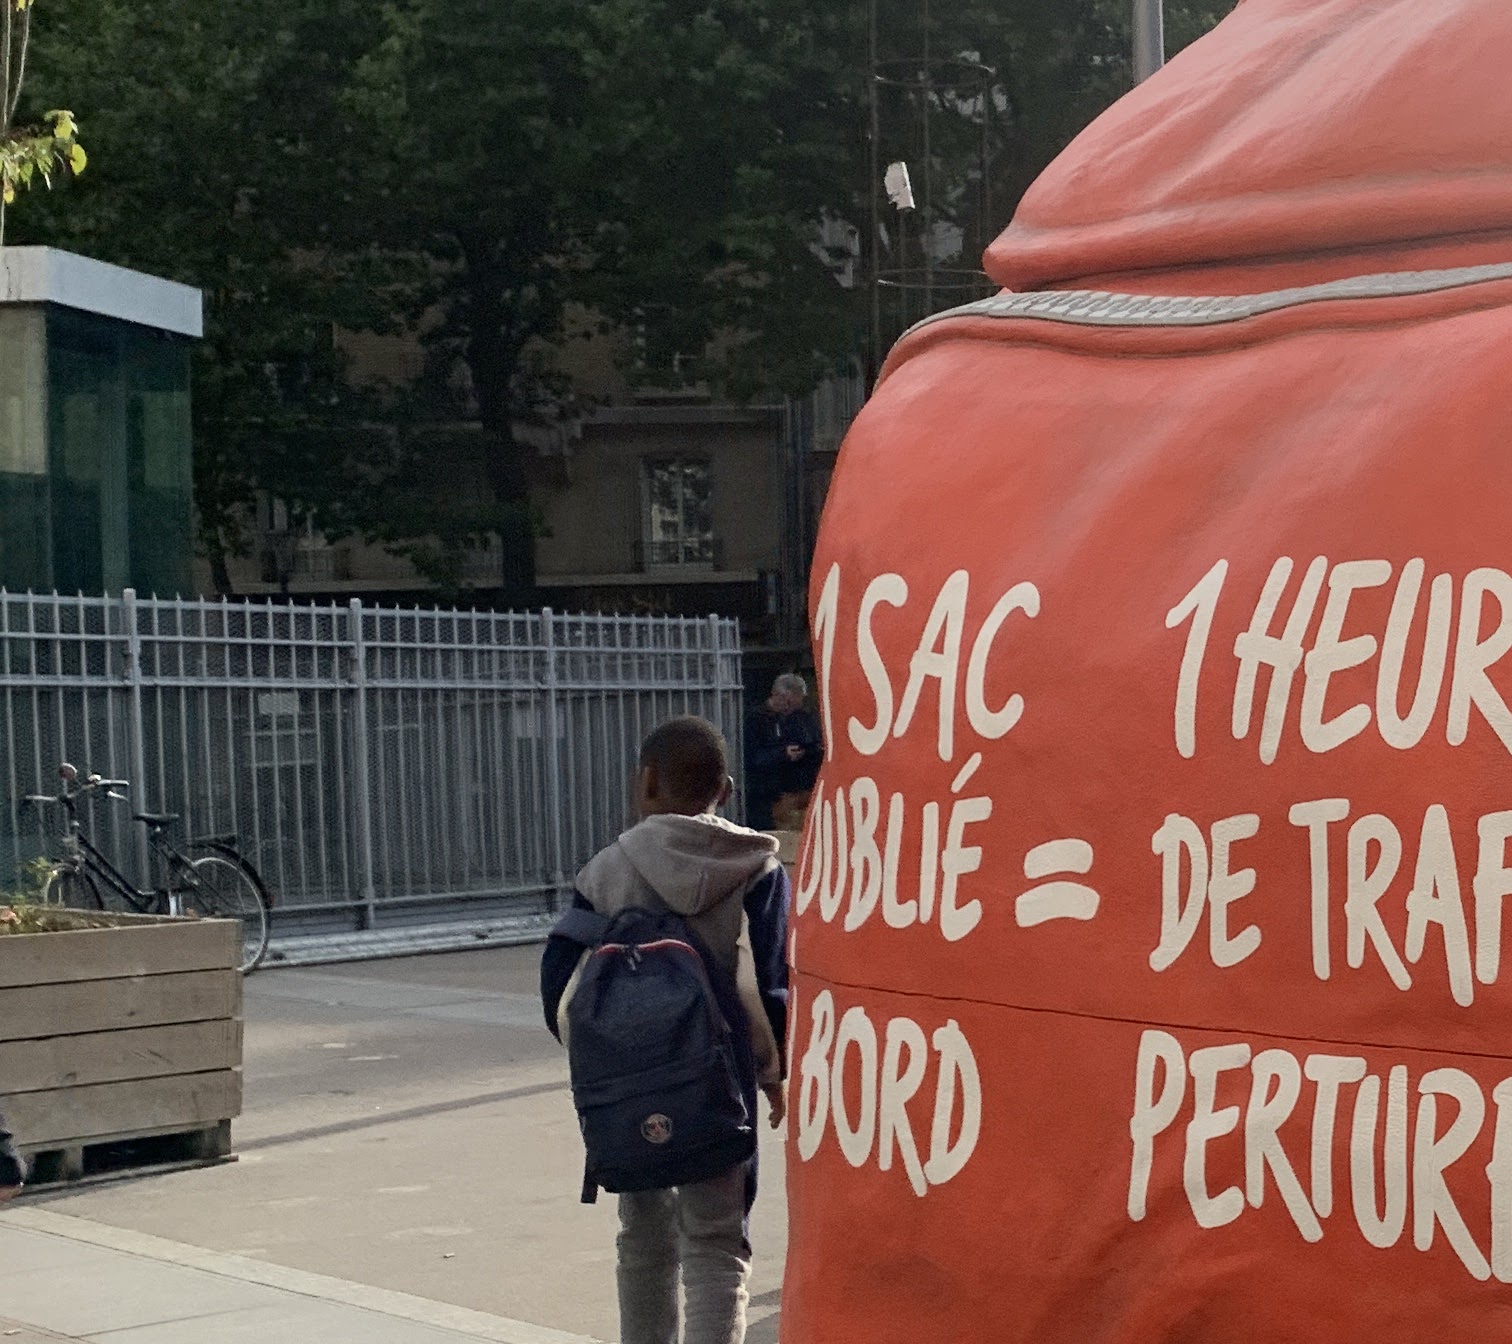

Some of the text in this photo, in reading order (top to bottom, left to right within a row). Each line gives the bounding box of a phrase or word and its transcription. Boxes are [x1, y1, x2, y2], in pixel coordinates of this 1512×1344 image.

[815, 562, 1041, 762] 1 SAC
[1165, 558, 1230, 759] 1
[1149, 813, 1262, 973] DE
[797, 989, 984, 1197] BORD
